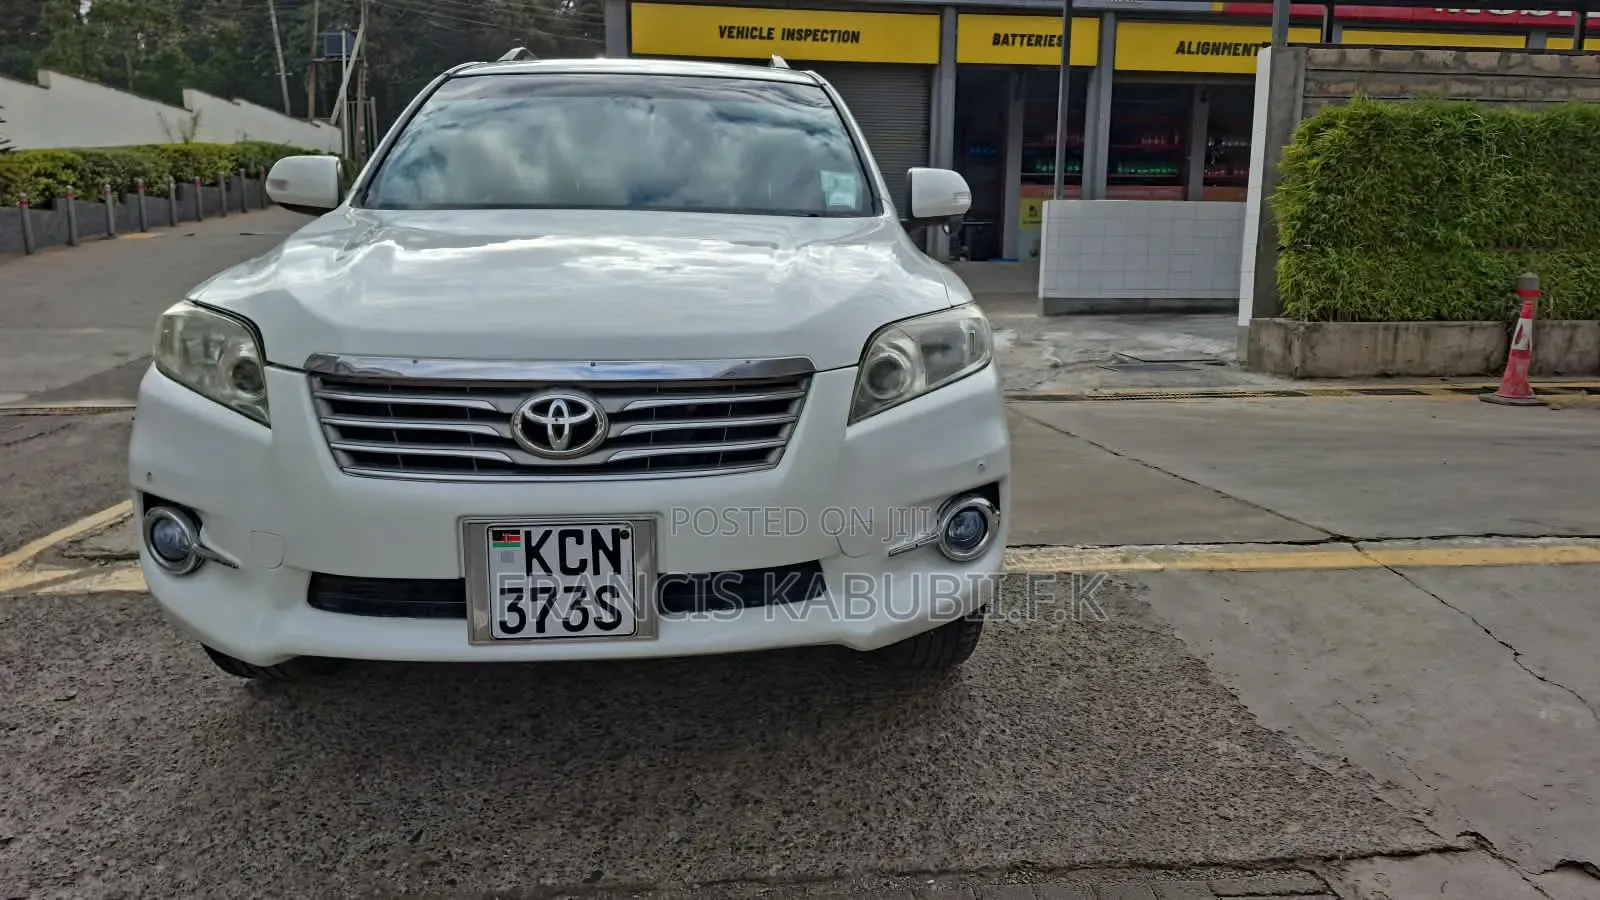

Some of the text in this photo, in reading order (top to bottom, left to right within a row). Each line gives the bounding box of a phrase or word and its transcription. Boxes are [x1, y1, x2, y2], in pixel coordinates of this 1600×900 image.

[718, 25, 861, 43] VEHICLE INSPECTION
[992, 33, 1064, 47] BATTERIES
[1175, 41, 1262, 56] ALIGNMENT
[524, 528, 622, 577] KCN
[500, 584, 622, 634] 373S
